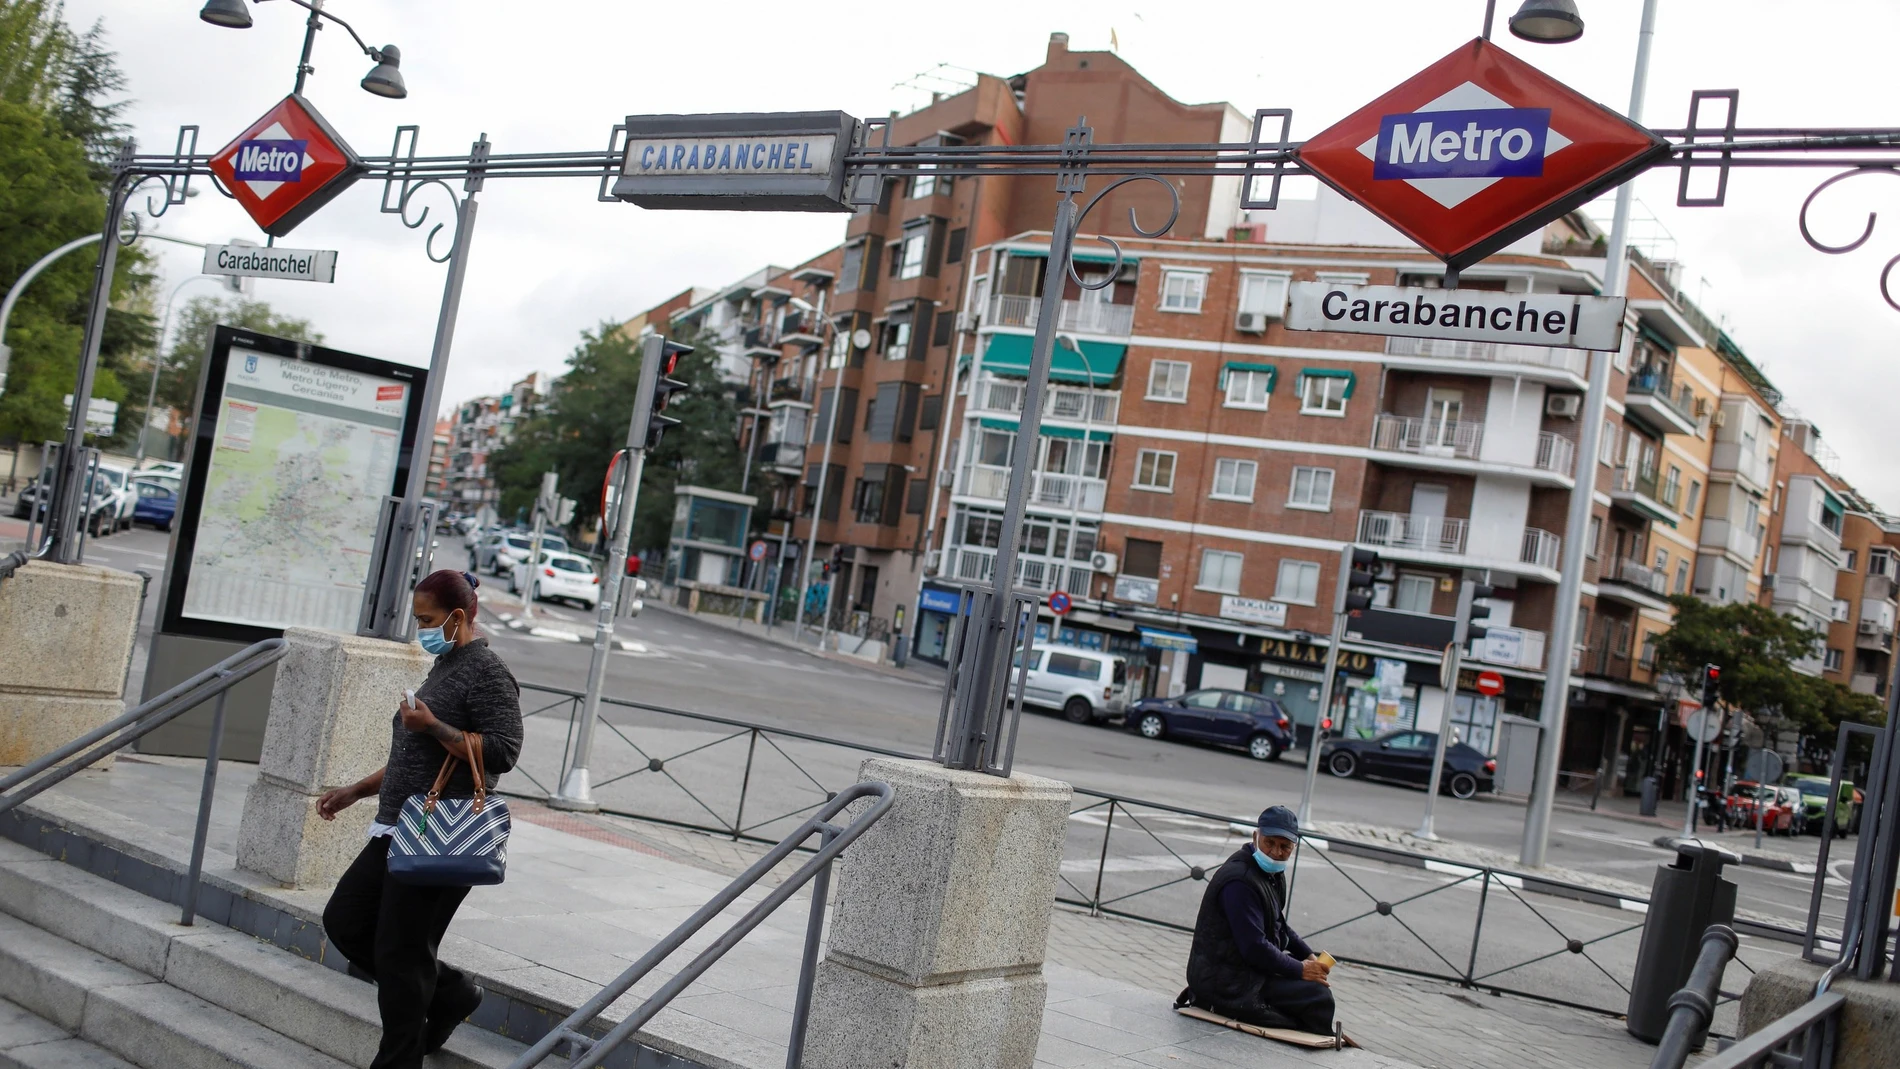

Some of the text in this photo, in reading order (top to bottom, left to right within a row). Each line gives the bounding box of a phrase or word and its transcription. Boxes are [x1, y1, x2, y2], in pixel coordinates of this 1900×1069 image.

[641, 142, 813, 170] CARABANCHEL
[1388, 121, 1533, 165] Metro
[239, 145, 299, 173] Metro
[217, 250, 312, 274] Carabanchel
[1321, 290, 1581, 336] Carabanchel
[280, 359, 363, 386] Plano de Metro,
[282, 371, 358, 395] Metro Ligero y
[292, 383, 345, 401] Cercanías
[1231, 598, 1280, 612] ABOGADO
